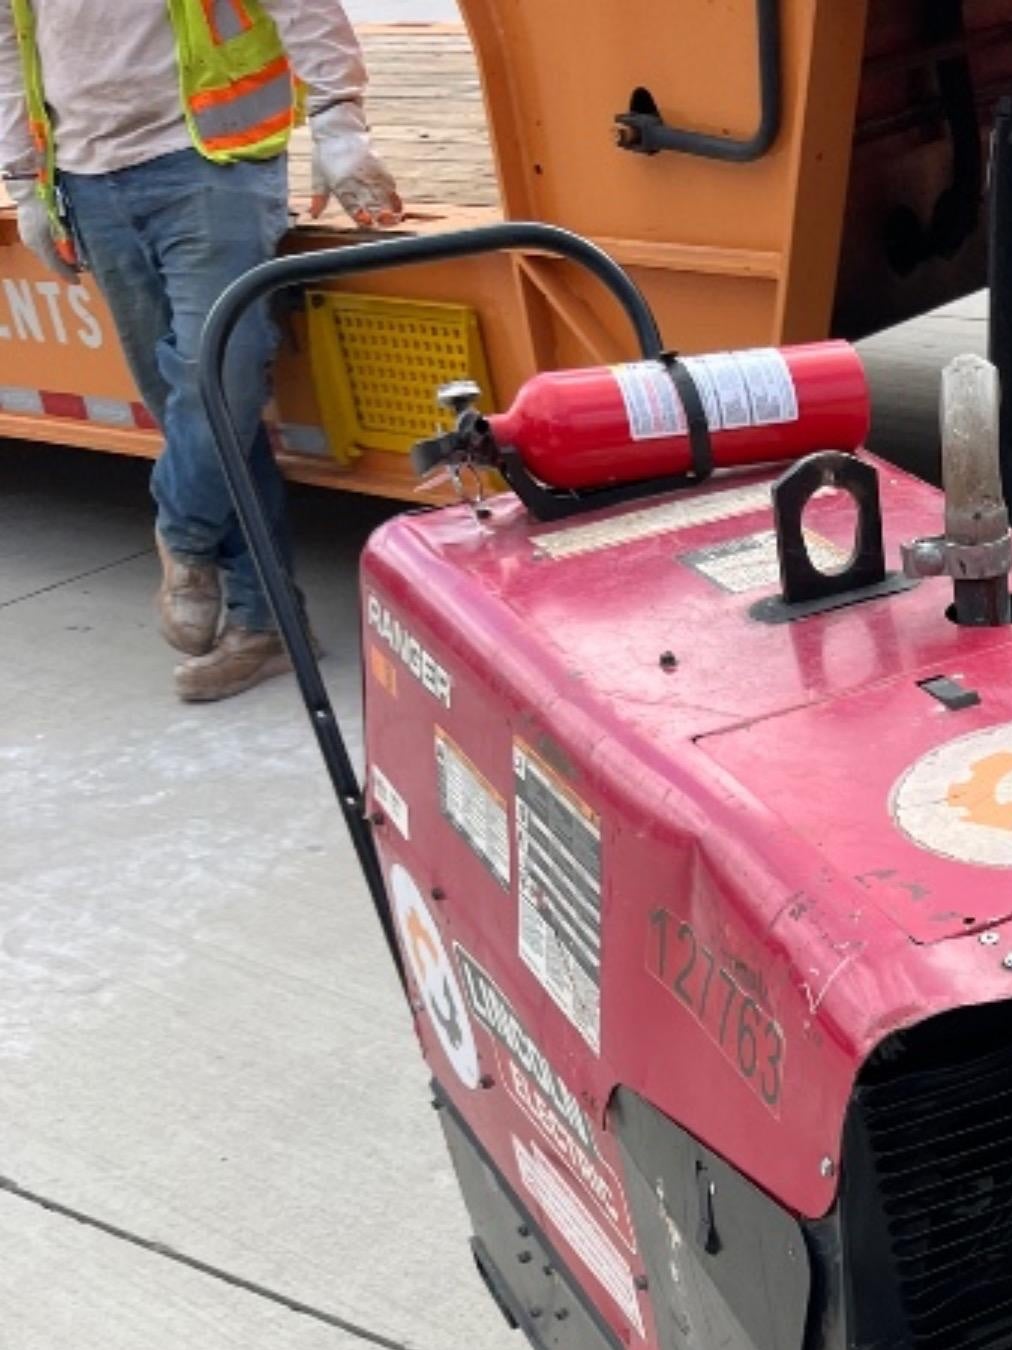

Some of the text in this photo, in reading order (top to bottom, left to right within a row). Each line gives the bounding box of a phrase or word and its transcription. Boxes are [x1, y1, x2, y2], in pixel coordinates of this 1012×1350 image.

[0, 278, 102, 348] NTS
[367, 595, 452, 709] RANGER
[650, 908, 782, 1105] 127763
